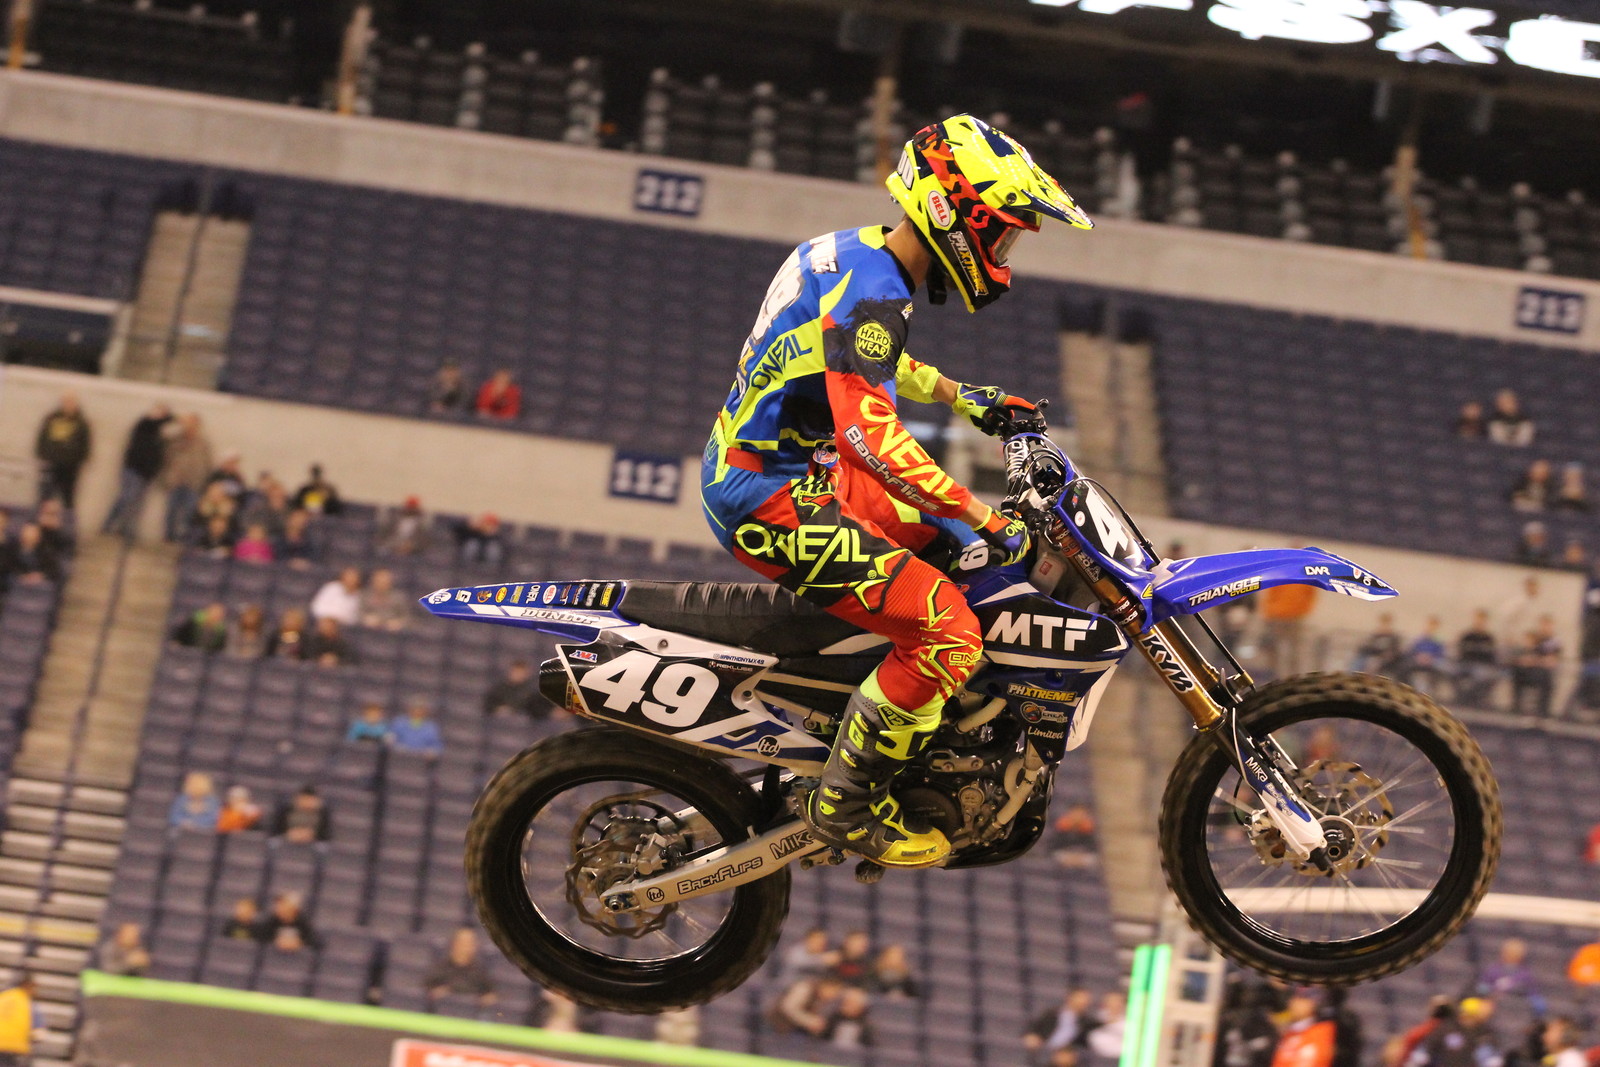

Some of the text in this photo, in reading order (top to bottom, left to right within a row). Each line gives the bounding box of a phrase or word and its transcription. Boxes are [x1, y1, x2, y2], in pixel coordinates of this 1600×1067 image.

[932, 195, 948, 223] BELL
[861, 328, 889, 346] HARD
[858, 338, 887, 357] WEAR
[616, 460, 678, 498] 112
[1304, 566, 1330, 576] DWR
[1189, 576, 1262, 607] TRIANGLE
[1230, 585, 1260, 597] CYCLES
[985, 611, 1098, 651] MTF
[571, 650, 597, 661] AMA
[1139, 633, 1196, 694] KYB
[579, 650, 720, 728] 49
[1008, 684, 1077, 701] PHXTREME
[1028, 726, 1064, 739] Limited
[757, 737, 780, 757] ltd
